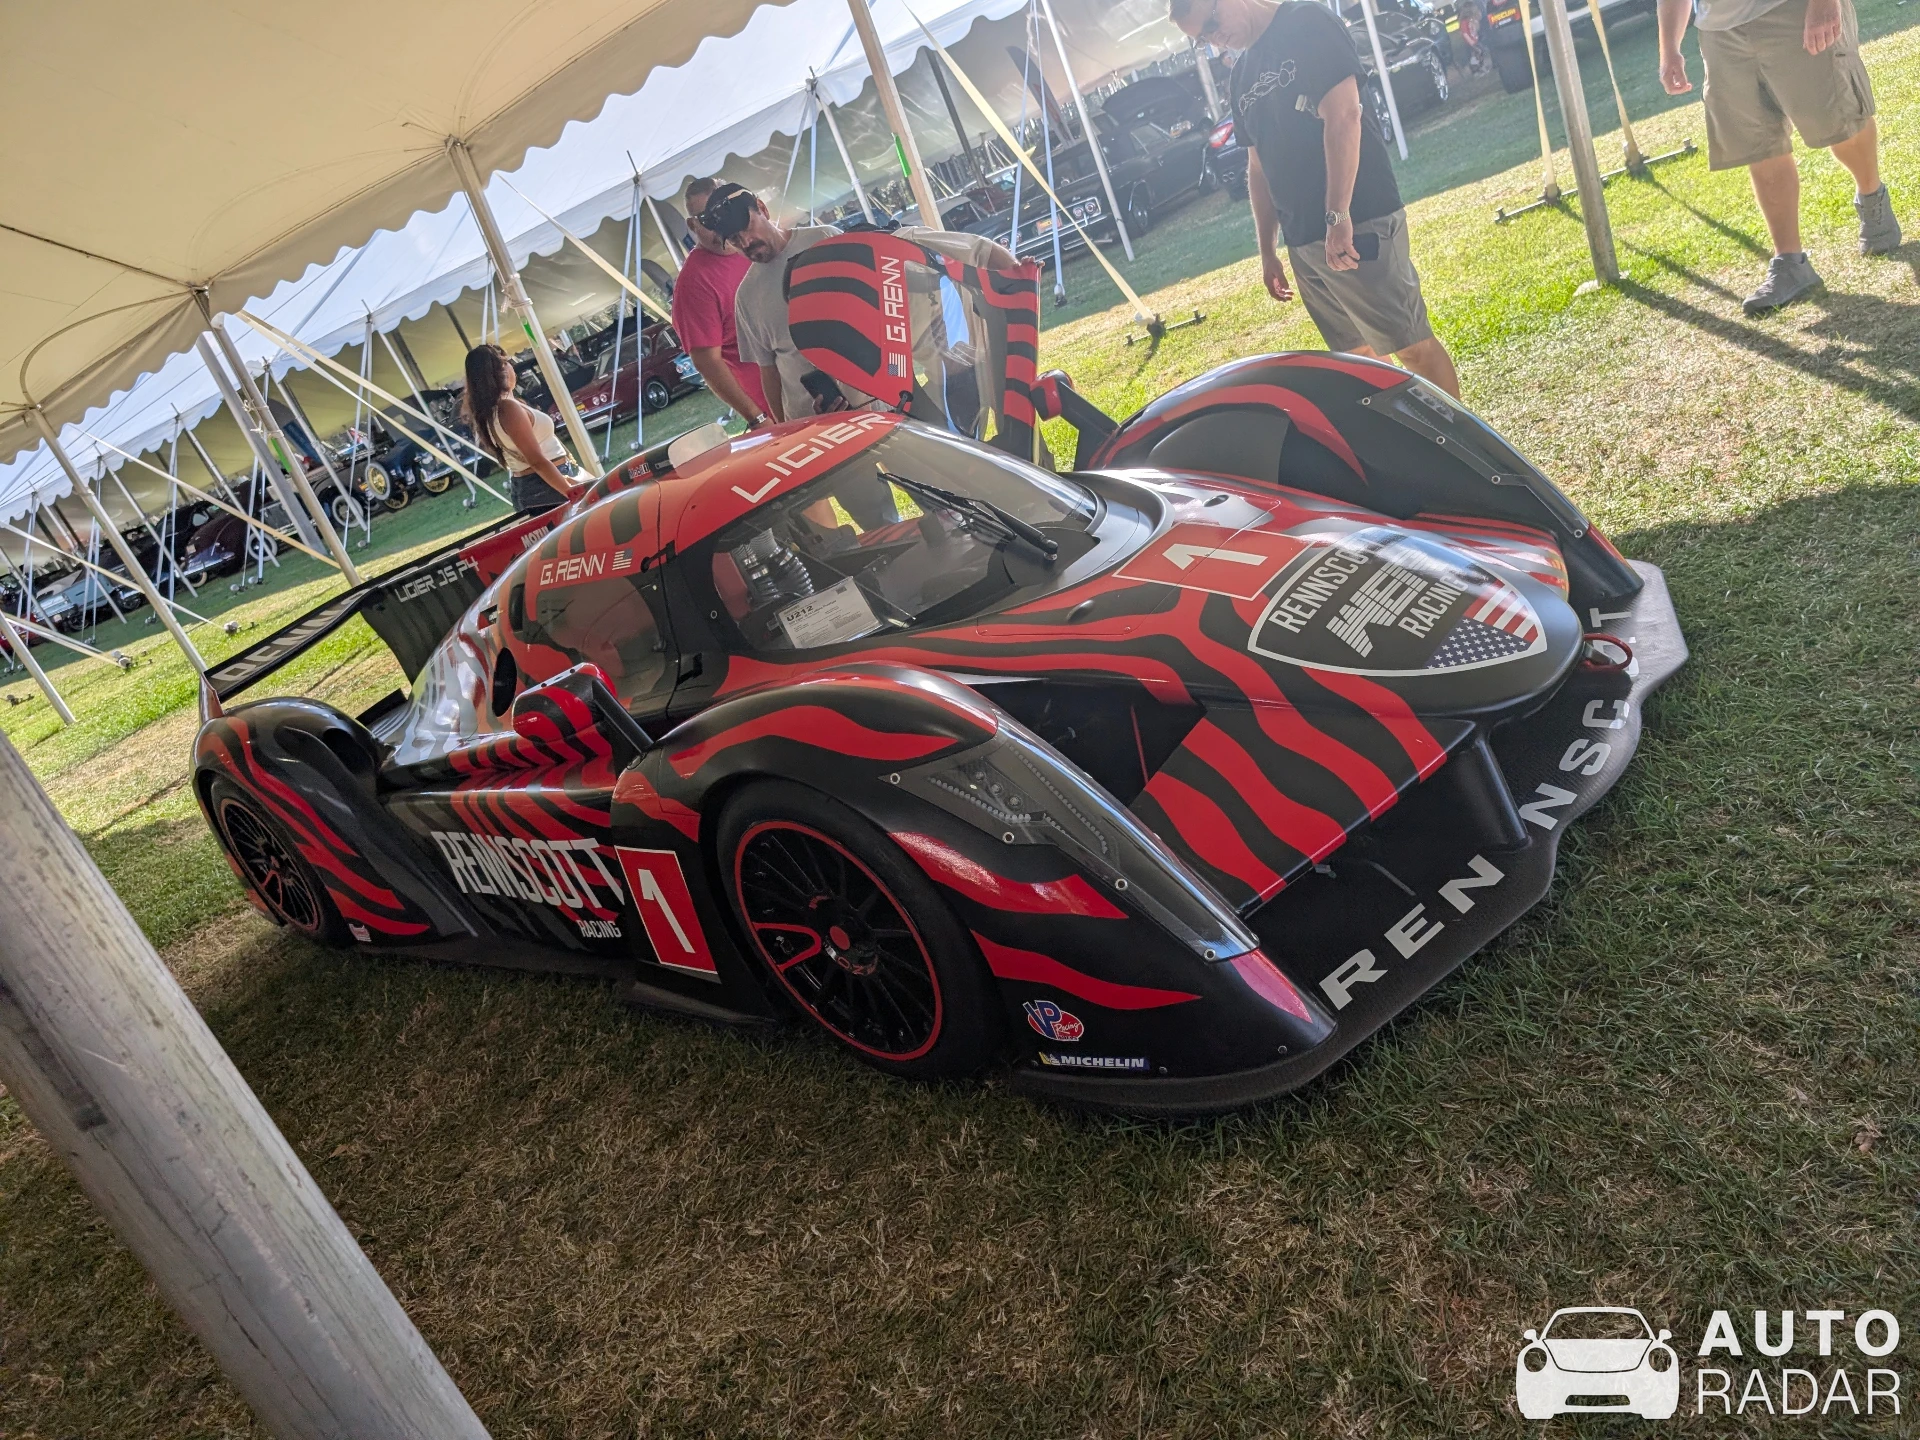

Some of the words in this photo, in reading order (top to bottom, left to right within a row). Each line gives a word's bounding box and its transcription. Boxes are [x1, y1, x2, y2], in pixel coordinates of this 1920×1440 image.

[731, 412, 895, 504] LIGIER
[395, 575, 437, 602] LIGIER
[437, 565, 458, 587] JS
[456, 556, 479, 578] P4
[1162, 543, 1268, 570] 1
[1268, 538, 1384, 633] RENNSCO
[1398, 575, 1469, 638] RACING
[786, 605, 814, 622] U212
[431, 830, 625, 909] RENNSCOTT
[576, 919, 622, 938] RACING
[638, 868, 696, 954] 1
[1023, 1000, 1062, 1040] VP
[1060, 1055, 1145, 1068] MICHELIN
